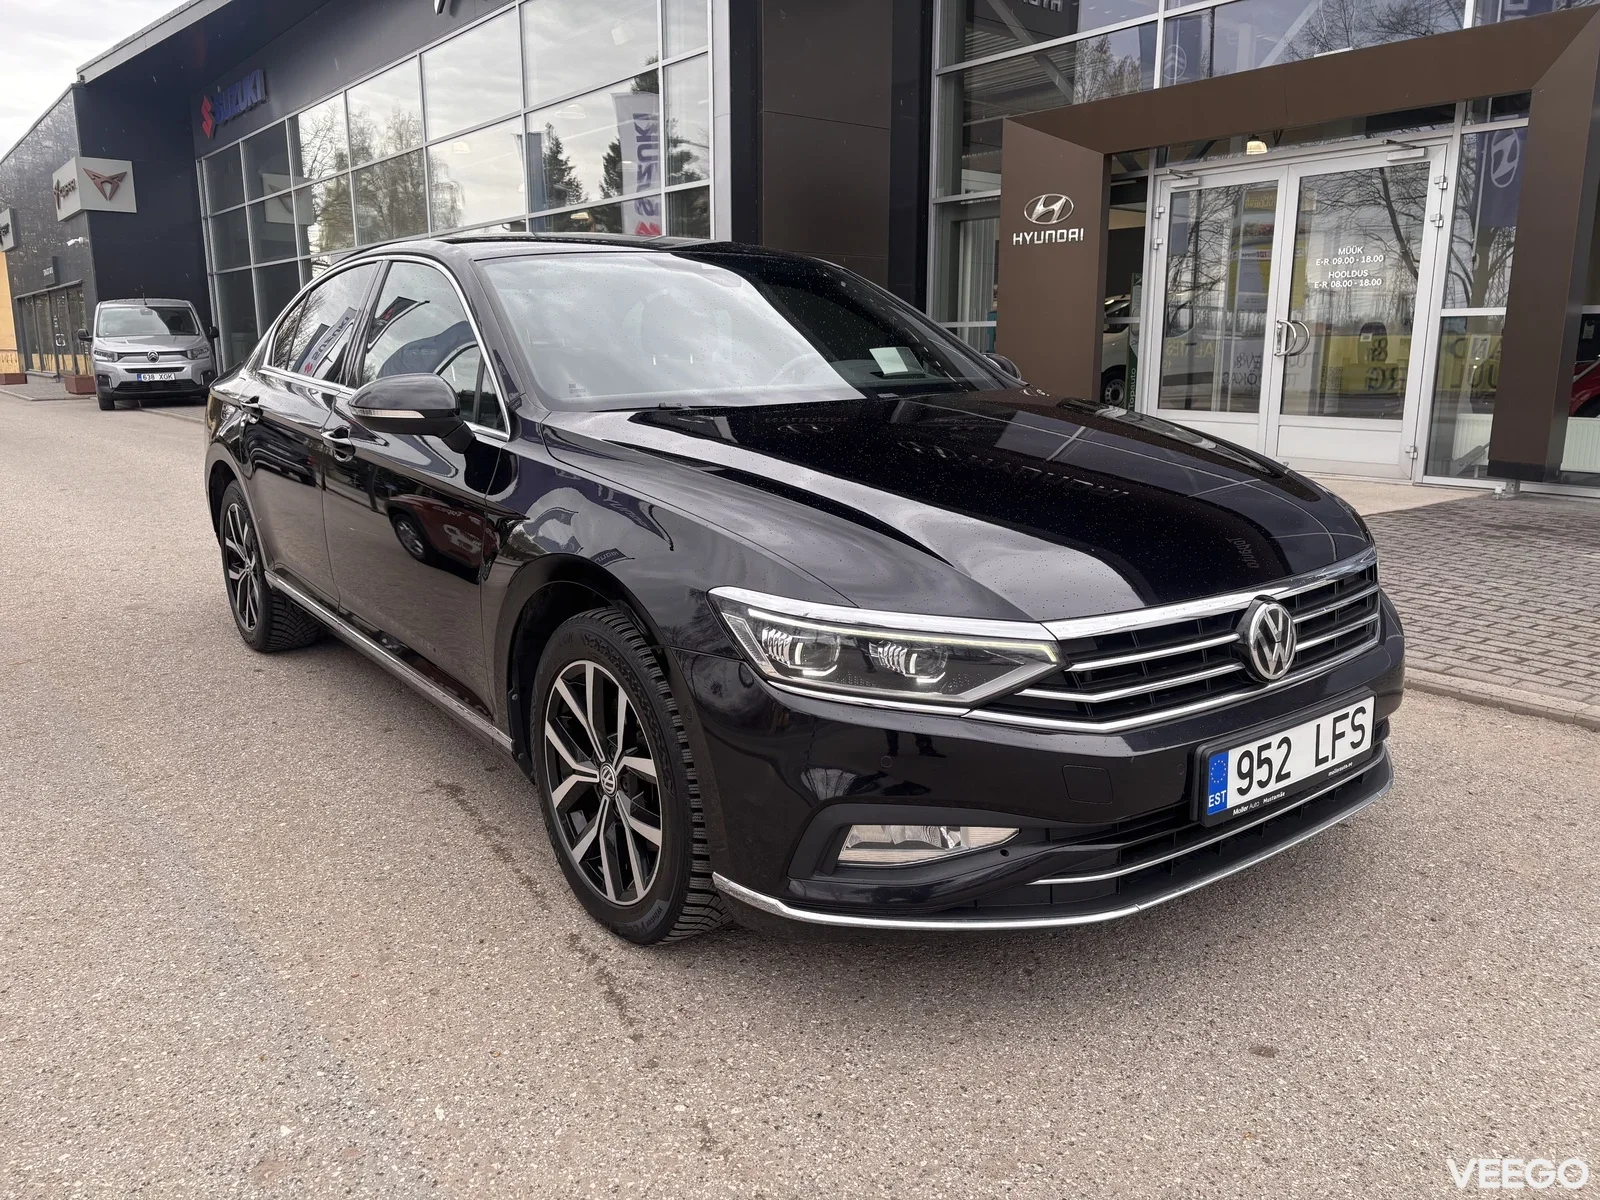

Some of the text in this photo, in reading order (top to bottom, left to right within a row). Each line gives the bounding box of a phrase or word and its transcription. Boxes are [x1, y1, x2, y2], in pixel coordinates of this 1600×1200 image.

[213, 68, 265, 125] SUZUKI
[1012, 227, 1085, 246] HYUNDAI
[1338, 245, 1363, 255] MÜÜK
[1332, 256, 1354, 265] 09.00
[1361, 254, 1384, 263] 18.00
[1328, 269, 1369, 279] HOOLDUS
[1330, 279, 1353, 288] 08.00
[1359, 278, 1383, 287] 18.00
[1128, 367, 1137, 410] Topauto
[1236, 706, 1367, 796] 952 LFS
[1208, 790, 1227, 808] EST
